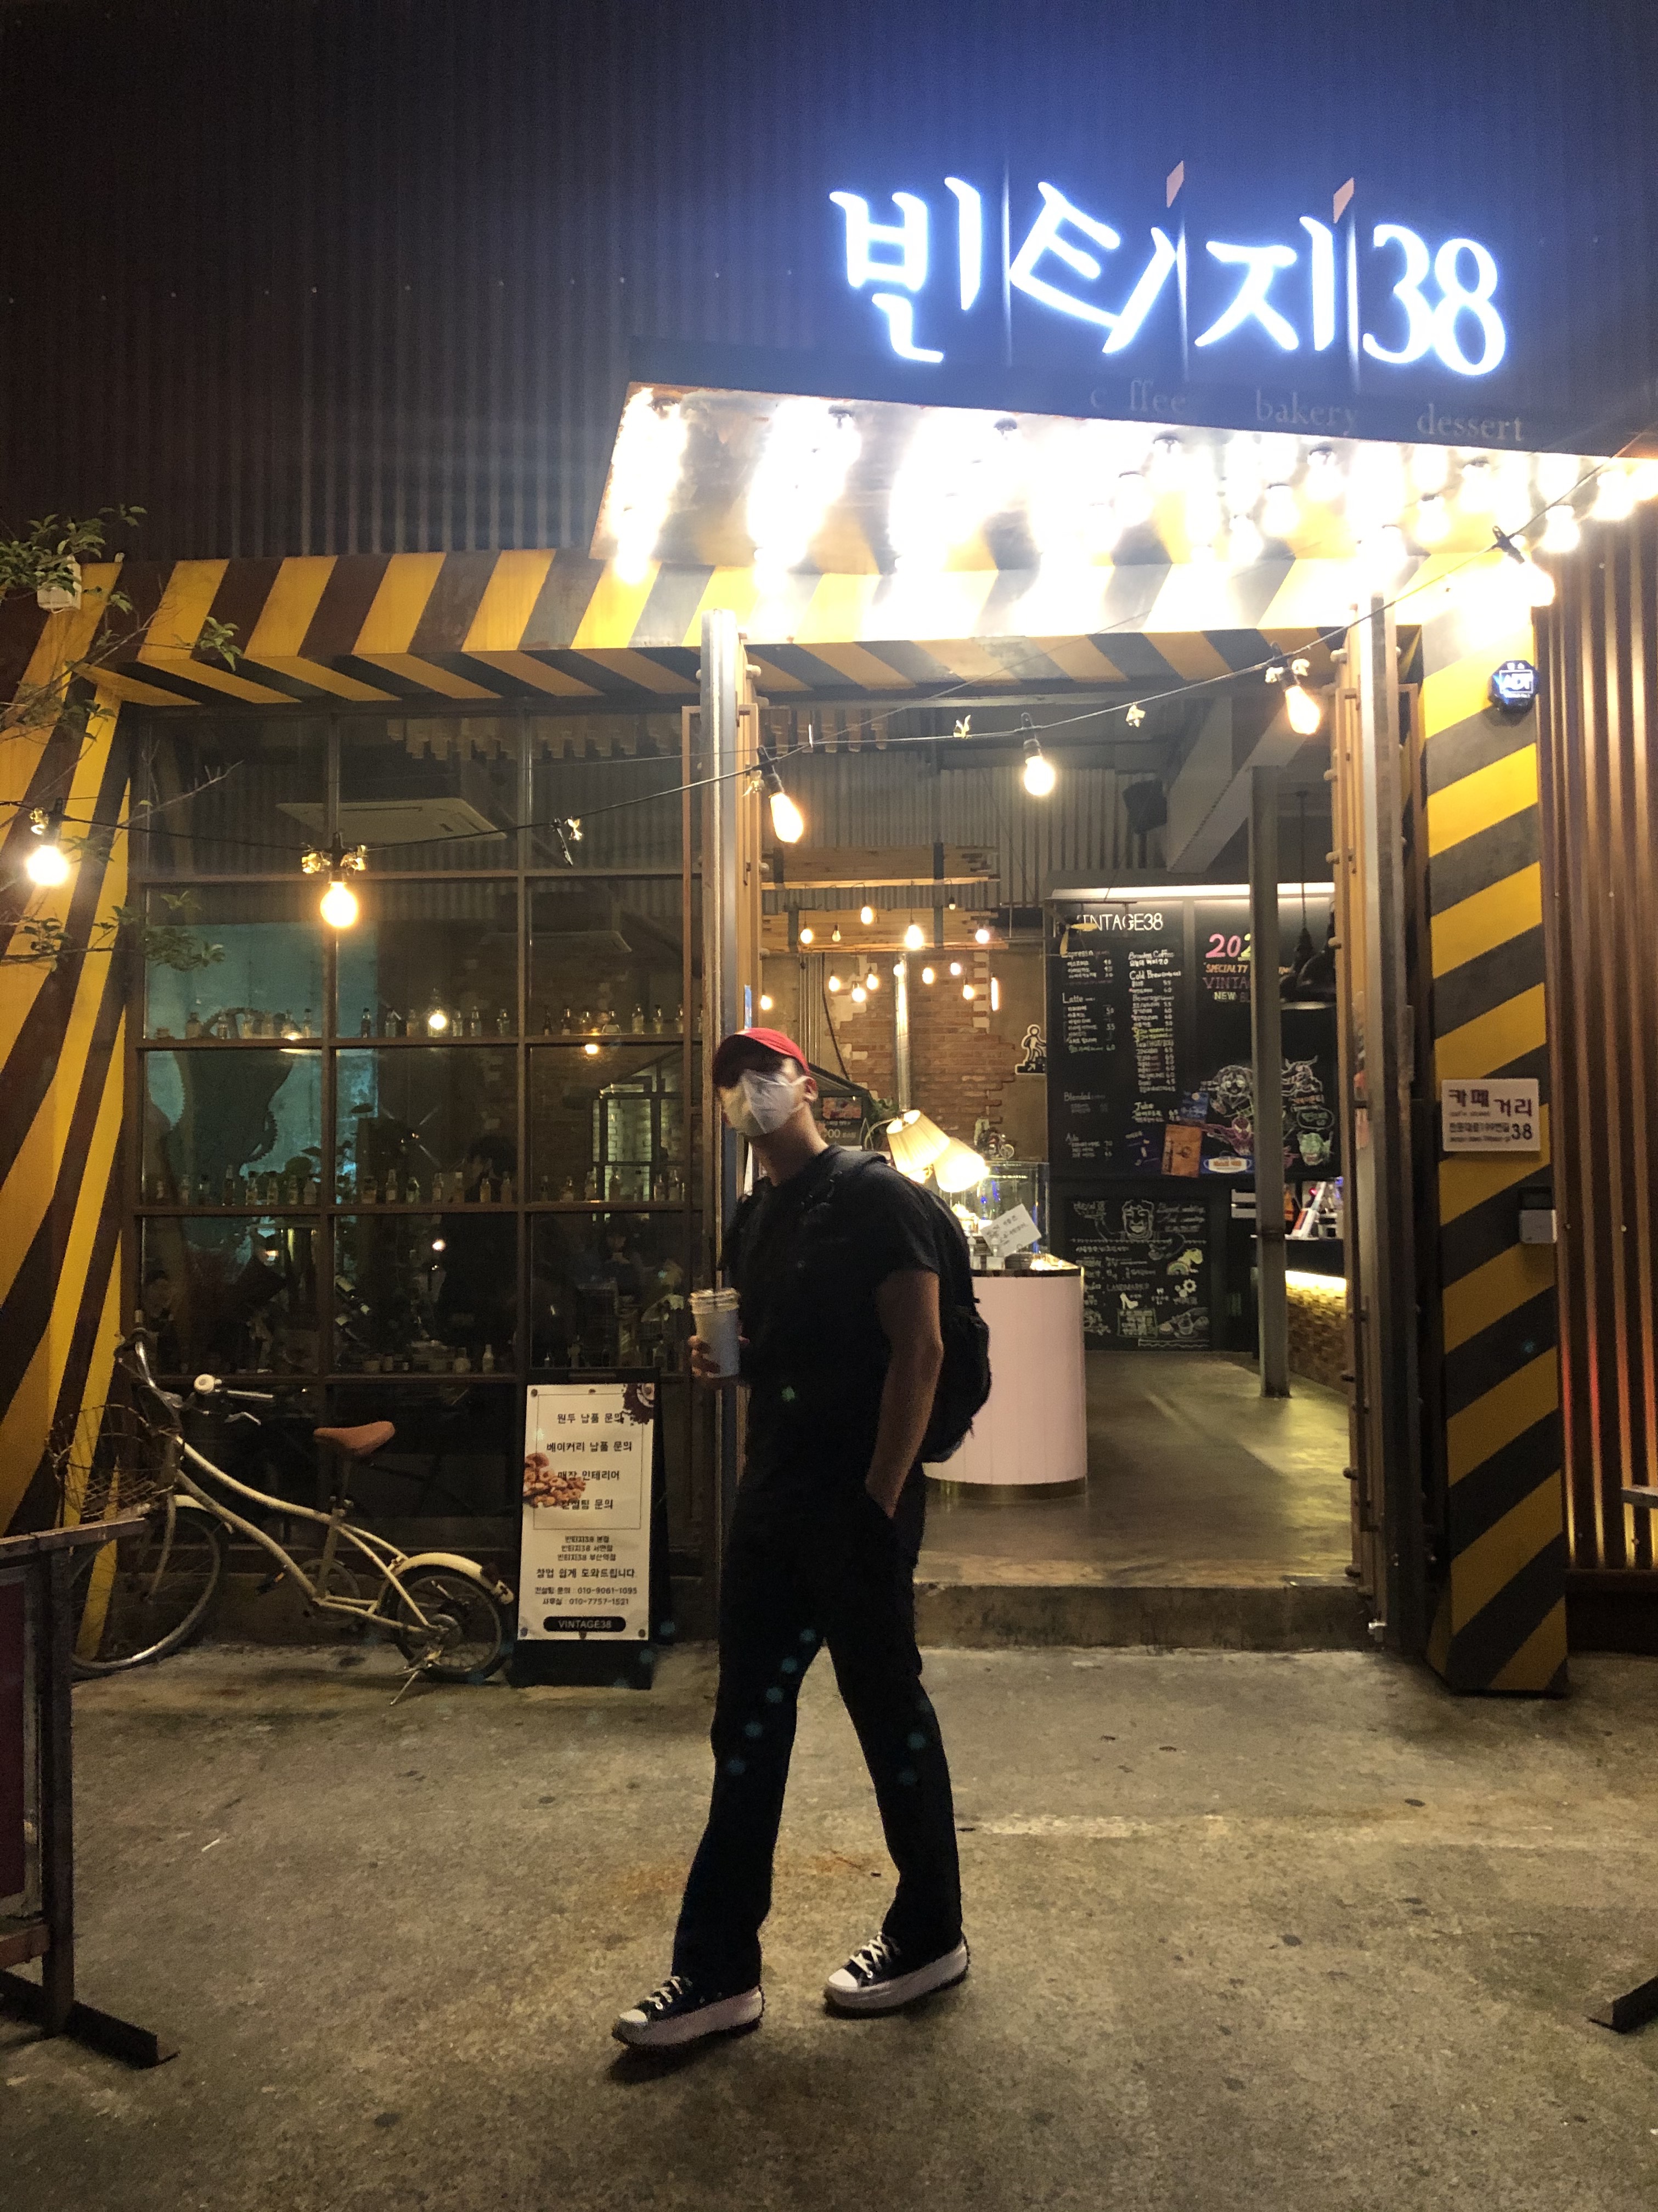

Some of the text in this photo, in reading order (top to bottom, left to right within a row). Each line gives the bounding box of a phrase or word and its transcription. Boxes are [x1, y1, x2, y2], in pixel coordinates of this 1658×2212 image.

[829, 177, 1507, 377] 빈티지38
[1255, 389, 1360, 437] bakery
[1417, 403, 1524, 442] dessert
[1062, 992, 1084, 1004] Latte
[1214, 991, 1236, 1000] NEW
[1510, 1123, 1533, 1140] 38
[557, 1413, 624, 1424] 원두 납품 문의
[546, 1442, 585, 1453] 베이커리
[613, 1441, 632, 1452] 문의
[582, 1470, 620, 1481] 인테리어
[594, 1499, 613, 1510] 문의
[537, 1568, 635, 1578] 창업 쉽게 도와드립니다
[558, 1620, 612, 1628] VINTAGE38
